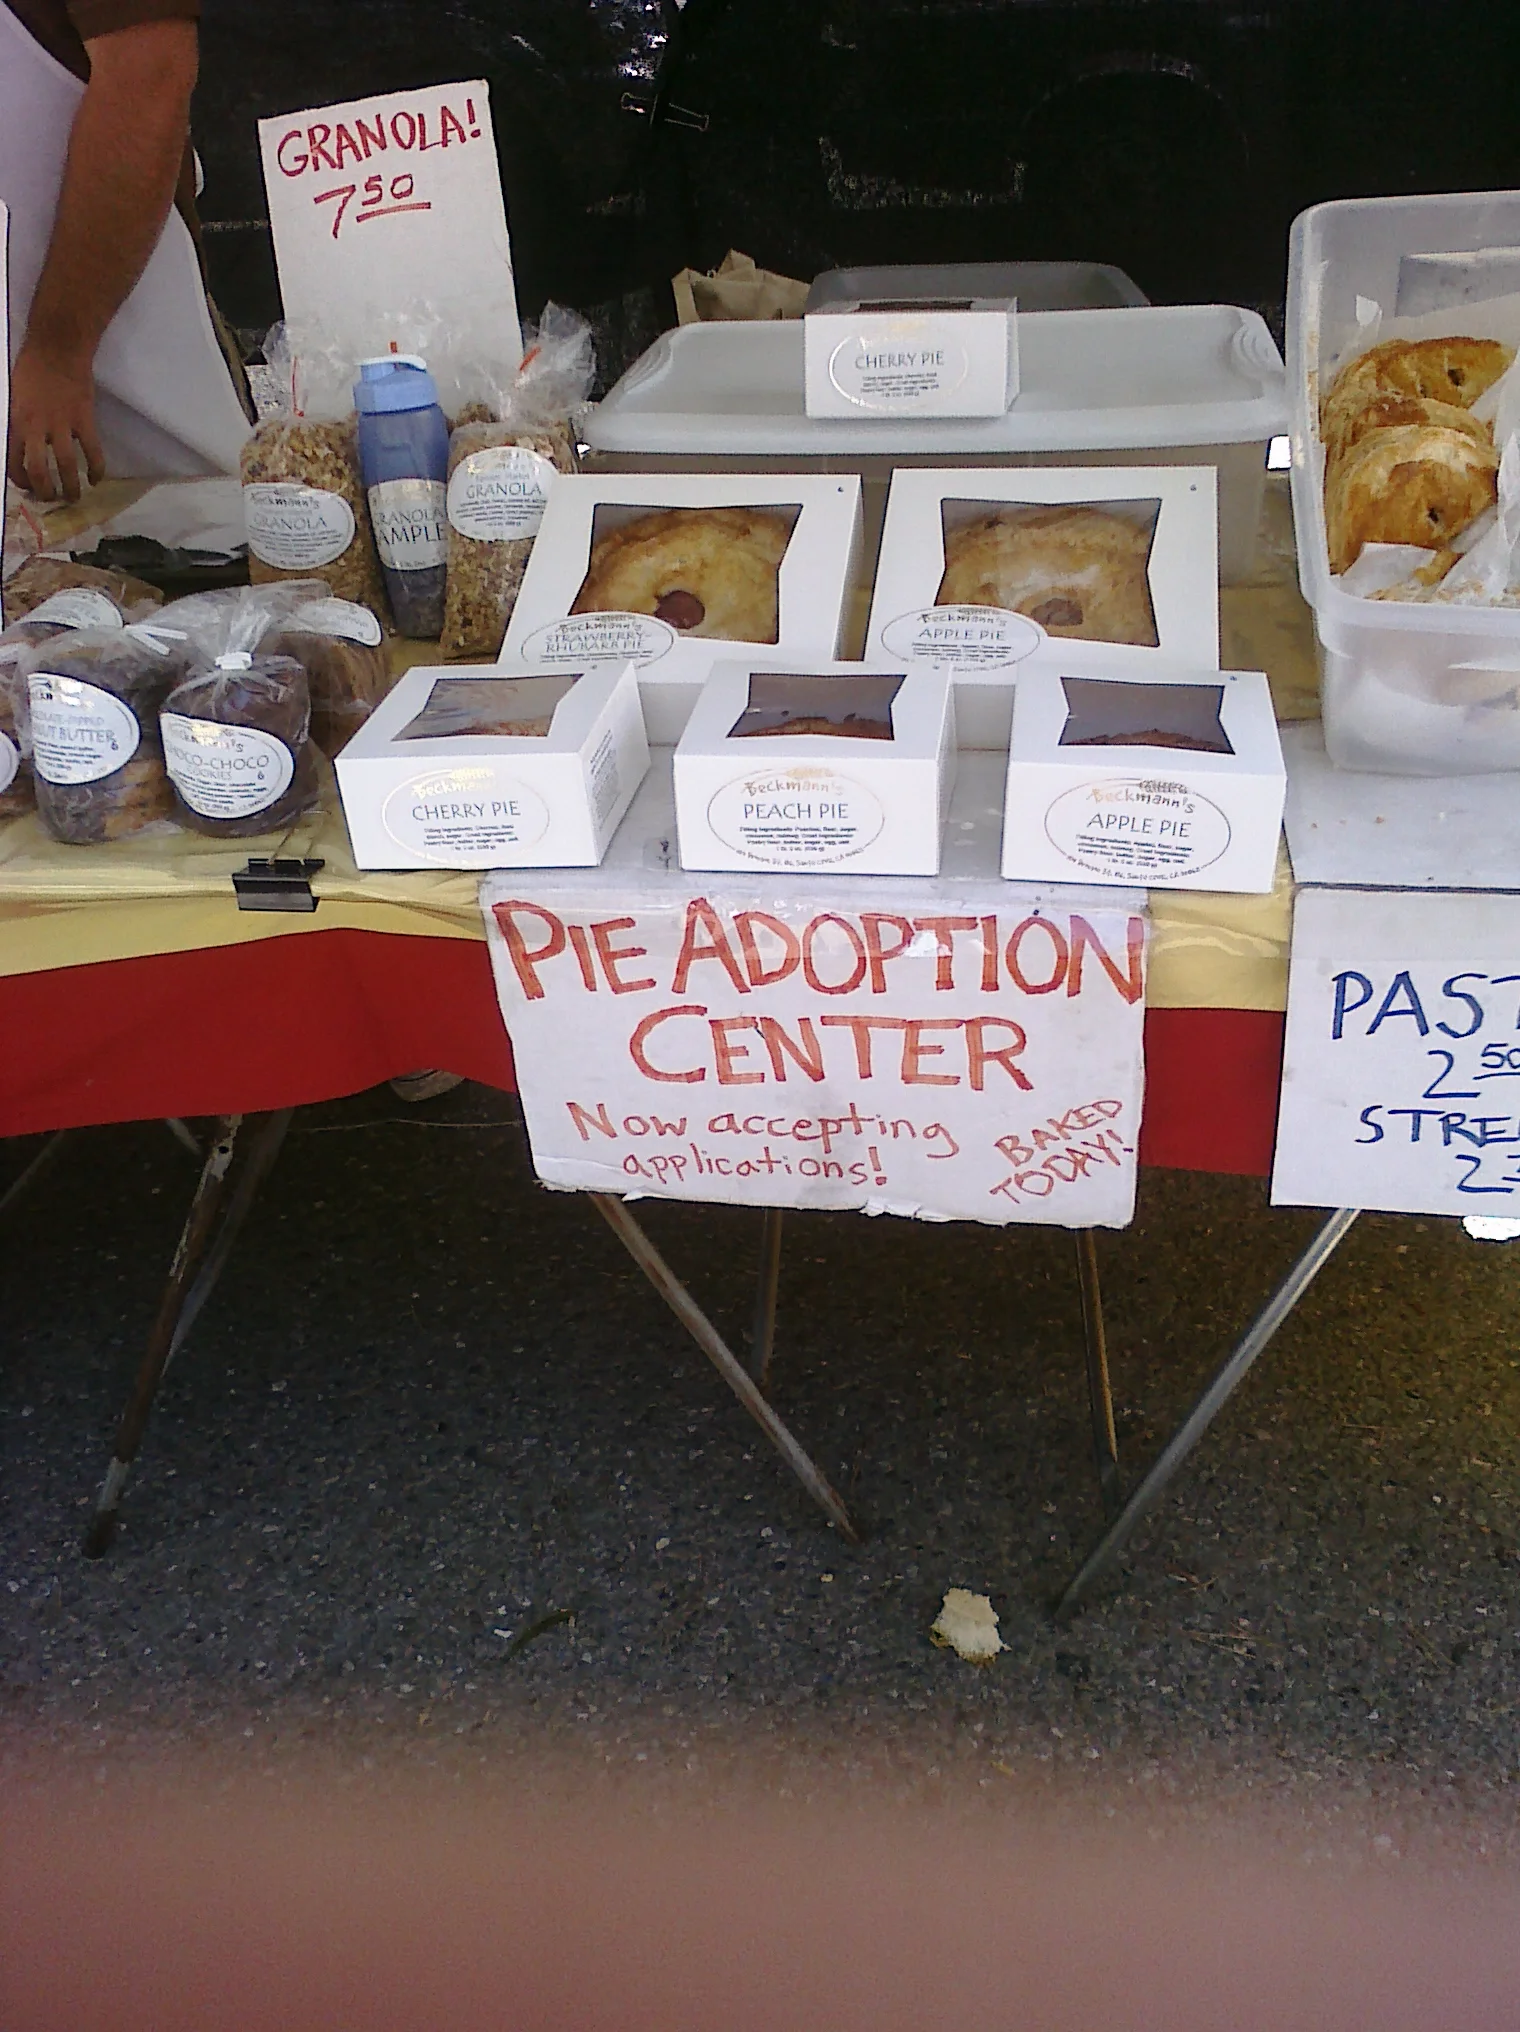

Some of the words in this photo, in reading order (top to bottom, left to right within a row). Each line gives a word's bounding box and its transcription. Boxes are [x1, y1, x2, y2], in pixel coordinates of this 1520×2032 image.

[277, 98, 481, 177] GRANOLA!
[855, 352, 917, 370] CHERRY
[922, 350, 945, 366] PIE
[466, 482, 542, 499] GRANOLA
[623, 640, 644, 650] PIE
[918, 628, 973, 641] APPLE
[979, 630, 1006, 641] PIE
[59, 727, 117, 743] BUTTER
[412, 802, 486, 822] CHERRY
[491, 800, 521, 817] PIE
[744, 803, 811, 820] PEACH
[820, 802, 849, 819] PIE
[1086, 787, 1196, 814] Beckmann's
[1086, 812, 1153, 835] APPLE
[1159, 819, 1192, 838] PIE
[492, 899, 657, 1000] PIE
[671, 897, 1145, 1005] ADOPTION
[629, 1004, 1034, 1091] CENTER
[566, 1102, 687, 1141] Now
[707, 1101, 960, 1159] accepting
[993, 1099, 1123, 1168] BAKED
[1353, 1105, 1520, 1149] STRE
[622, 1142, 888, 1186] applications!
[988, 1129, 1135, 1204] TODAY!
